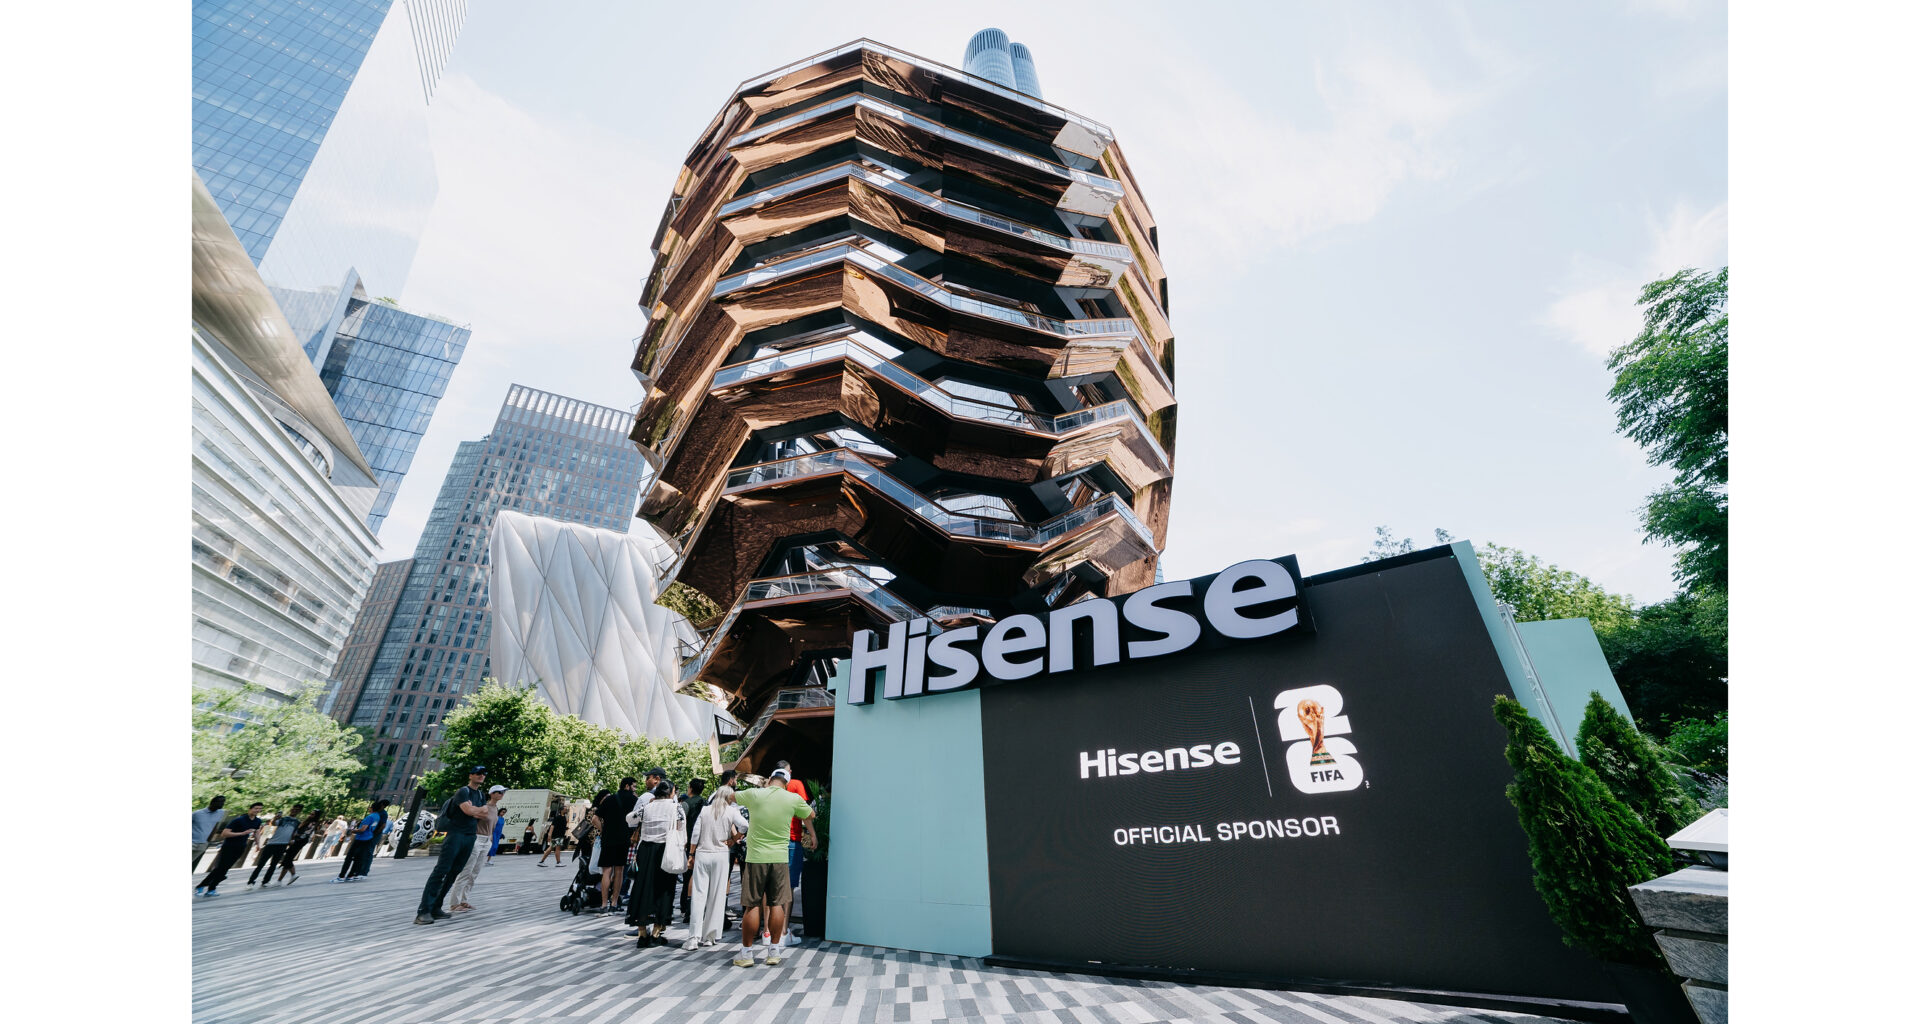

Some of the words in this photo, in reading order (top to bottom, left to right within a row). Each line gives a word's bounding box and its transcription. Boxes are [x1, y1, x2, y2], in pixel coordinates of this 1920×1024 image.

[847, 558, 1299, 705] Hisense
[1079, 741, 1241, 779] Hisense
[1310, 769, 1345, 783] FIFA
[1113, 824, 1212, 846] OFFICIAL
[1216, 815, 1341, 842] SPONSOR
